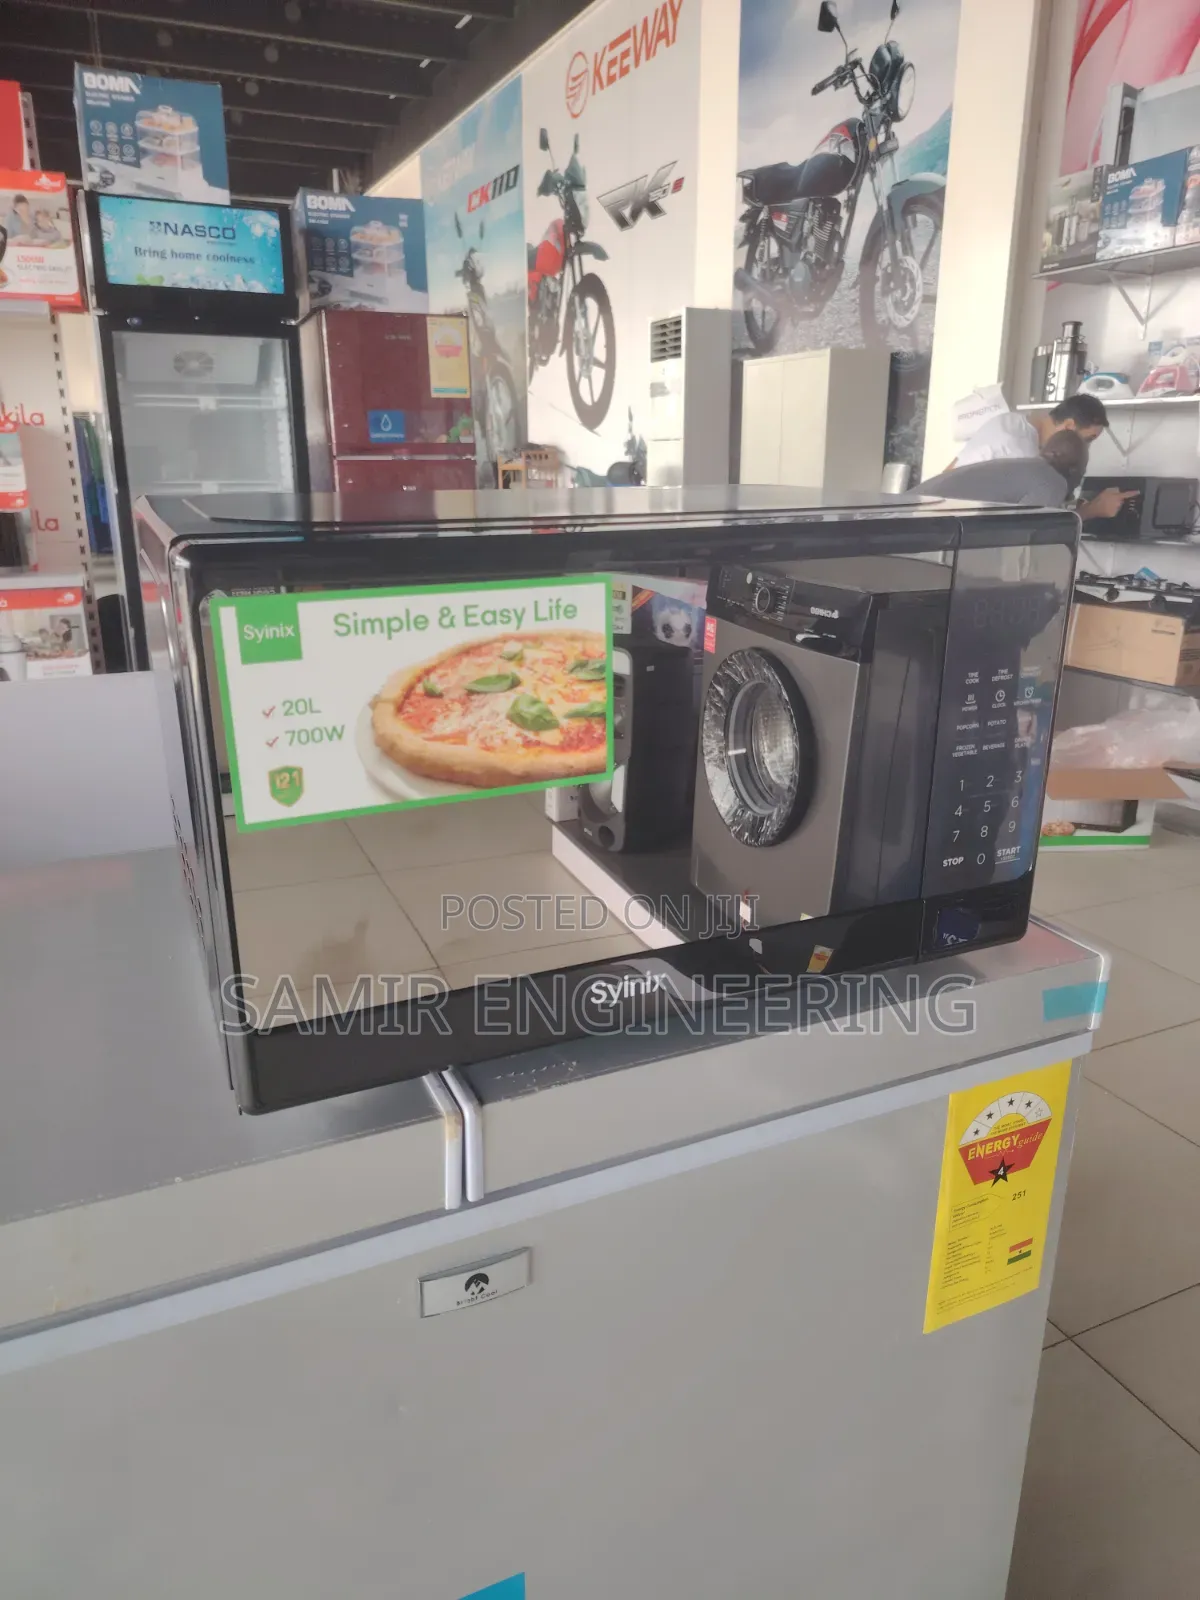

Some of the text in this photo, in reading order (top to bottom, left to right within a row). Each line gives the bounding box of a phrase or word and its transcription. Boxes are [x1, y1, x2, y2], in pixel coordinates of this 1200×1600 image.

[592, 0, 683, 96] KEEWAY
[467, 164, 520, 214] CK110
[163, 222, 237, 241] NASCO
[134, 246, 256, 265] Bring home coolness
[333, 598, 578, 640] Simple & Easy Life
[243, 623, 295, 643] Syinix
[282, 697, 322, 717] 20L
[956, 723, 979, 731] POPCORN
[987, 719, 1006, 727] POTATO
[285, 725, 346, 747] 700W
[986, 775, 994, 788] 2
[1014, 770, 1022, 783] 3
[960, 779, 965, 792] 1
[983, 800, 991, 812] 5
[1011, 796, 1019, 808] 6
[954, 804, 962, 817] 4
[980, 825, 988, 838] 8
[1008, 820, 1016, 833] 9
[952, 830, 960, 842] 7
[997, 846, 1021, 857] START
[942, 856, 964, 868] STOP
[976, 853, 986, 865] 0
[590, 971, 667, 1009] Syinix
[967, 1132, 1044, 1160] ENERGY guide
[997, 1166, 1004, 1176] 4
[1012, 1189, 1027, 1201] 251
[480, 1289, 498, 1300] Cool
